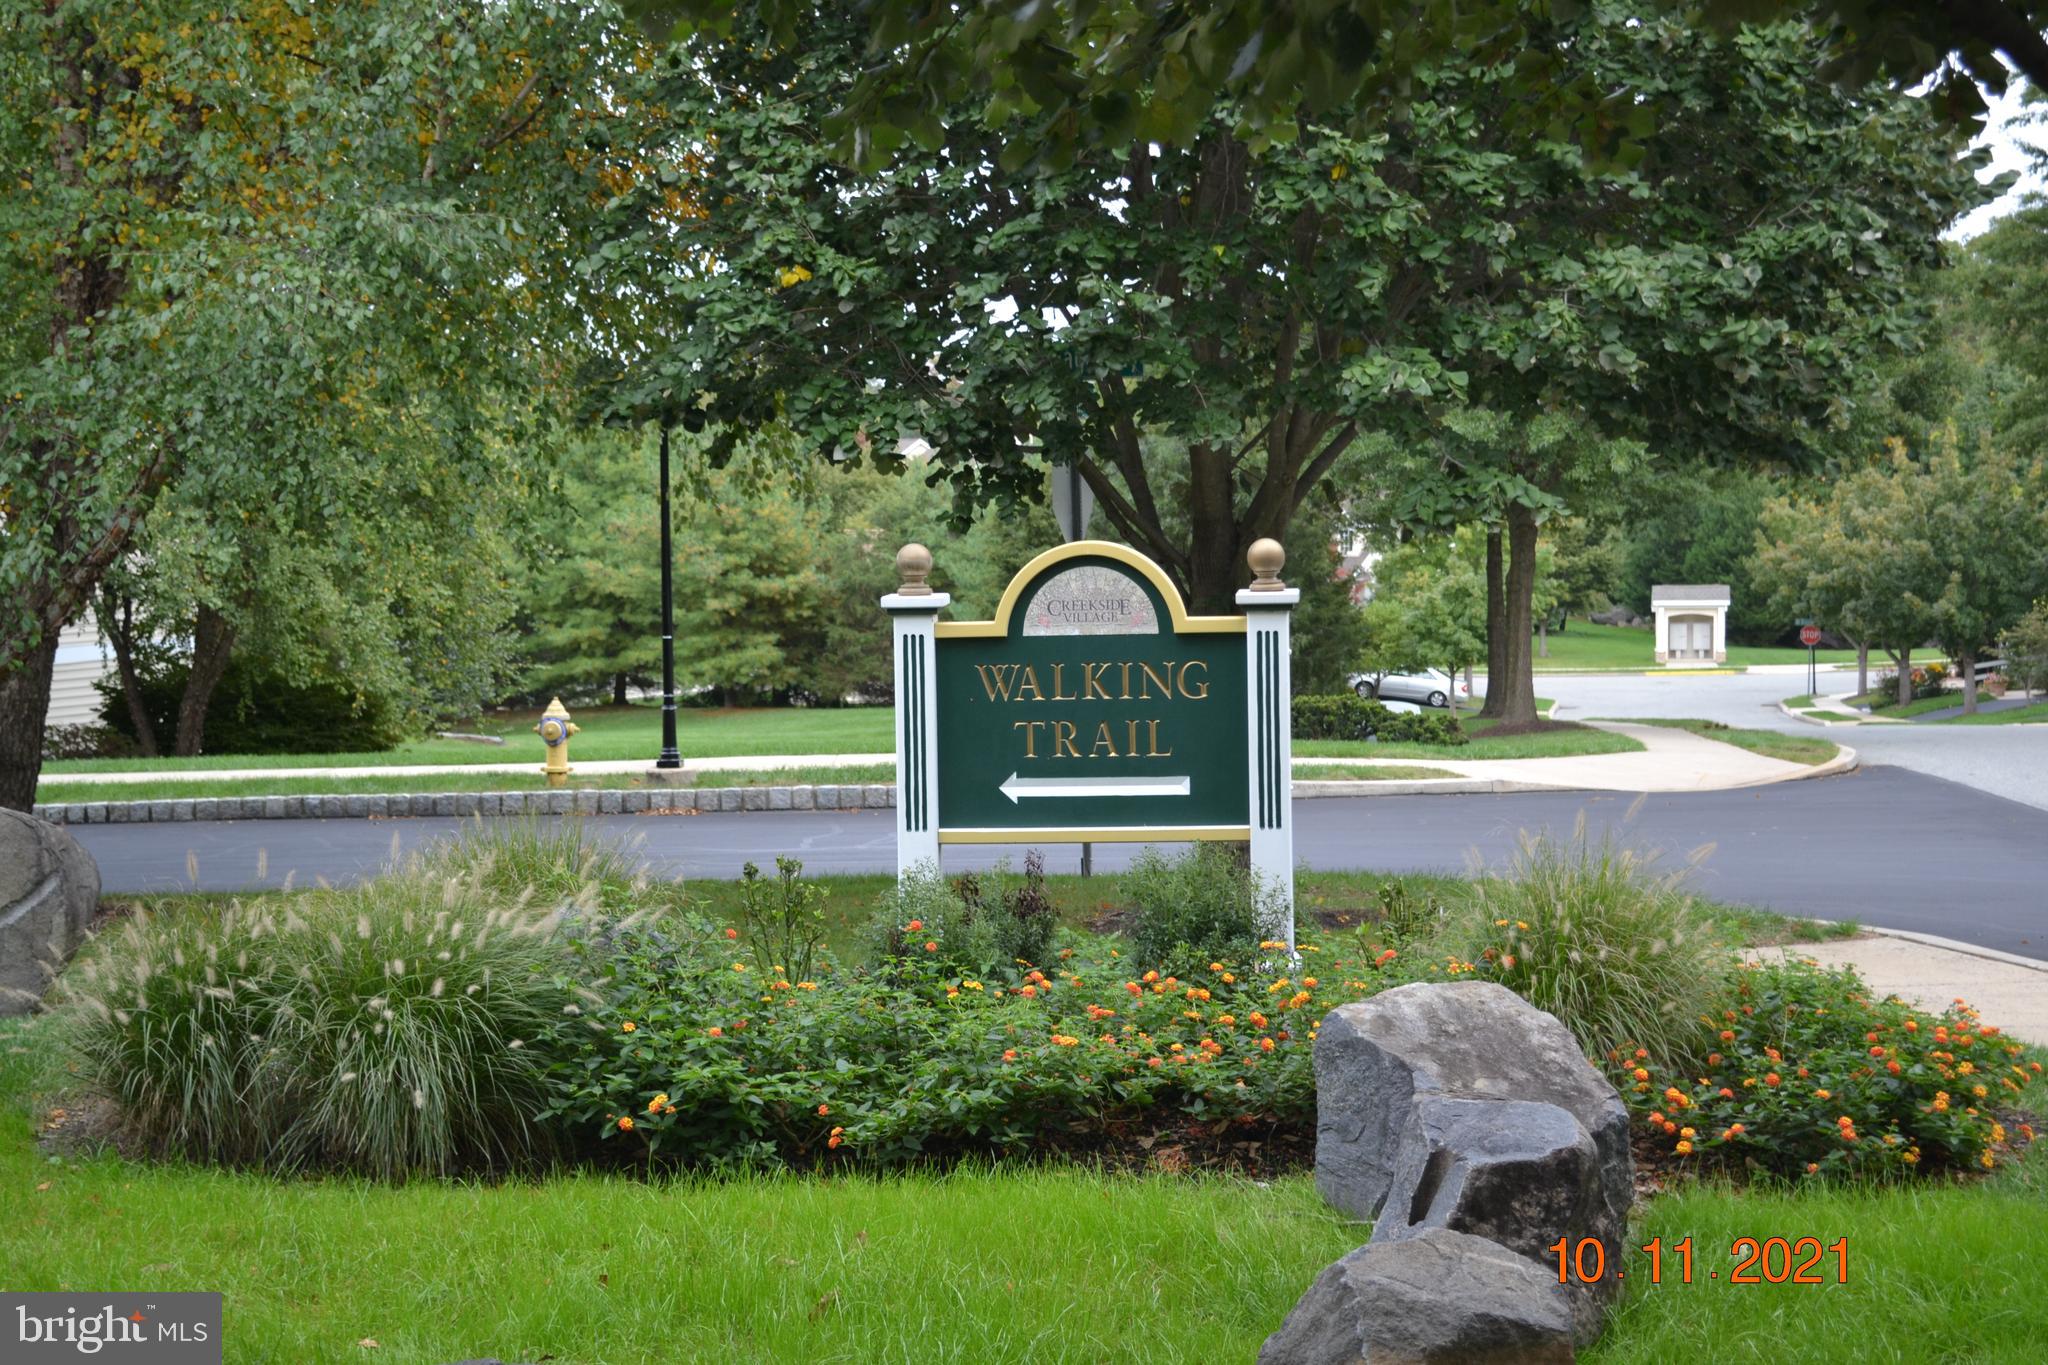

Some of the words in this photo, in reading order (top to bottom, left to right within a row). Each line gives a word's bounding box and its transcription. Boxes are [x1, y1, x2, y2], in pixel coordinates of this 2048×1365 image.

[1047, 599, 1131, 616] CREEKSIDE
[1064, 613, 1120, 623] VILLAGE
[1802, 631, 1819, 639] STOP
[975, 661, 1210, 702] WALKING
[1013, 719, 1173, 758] TRAIL
